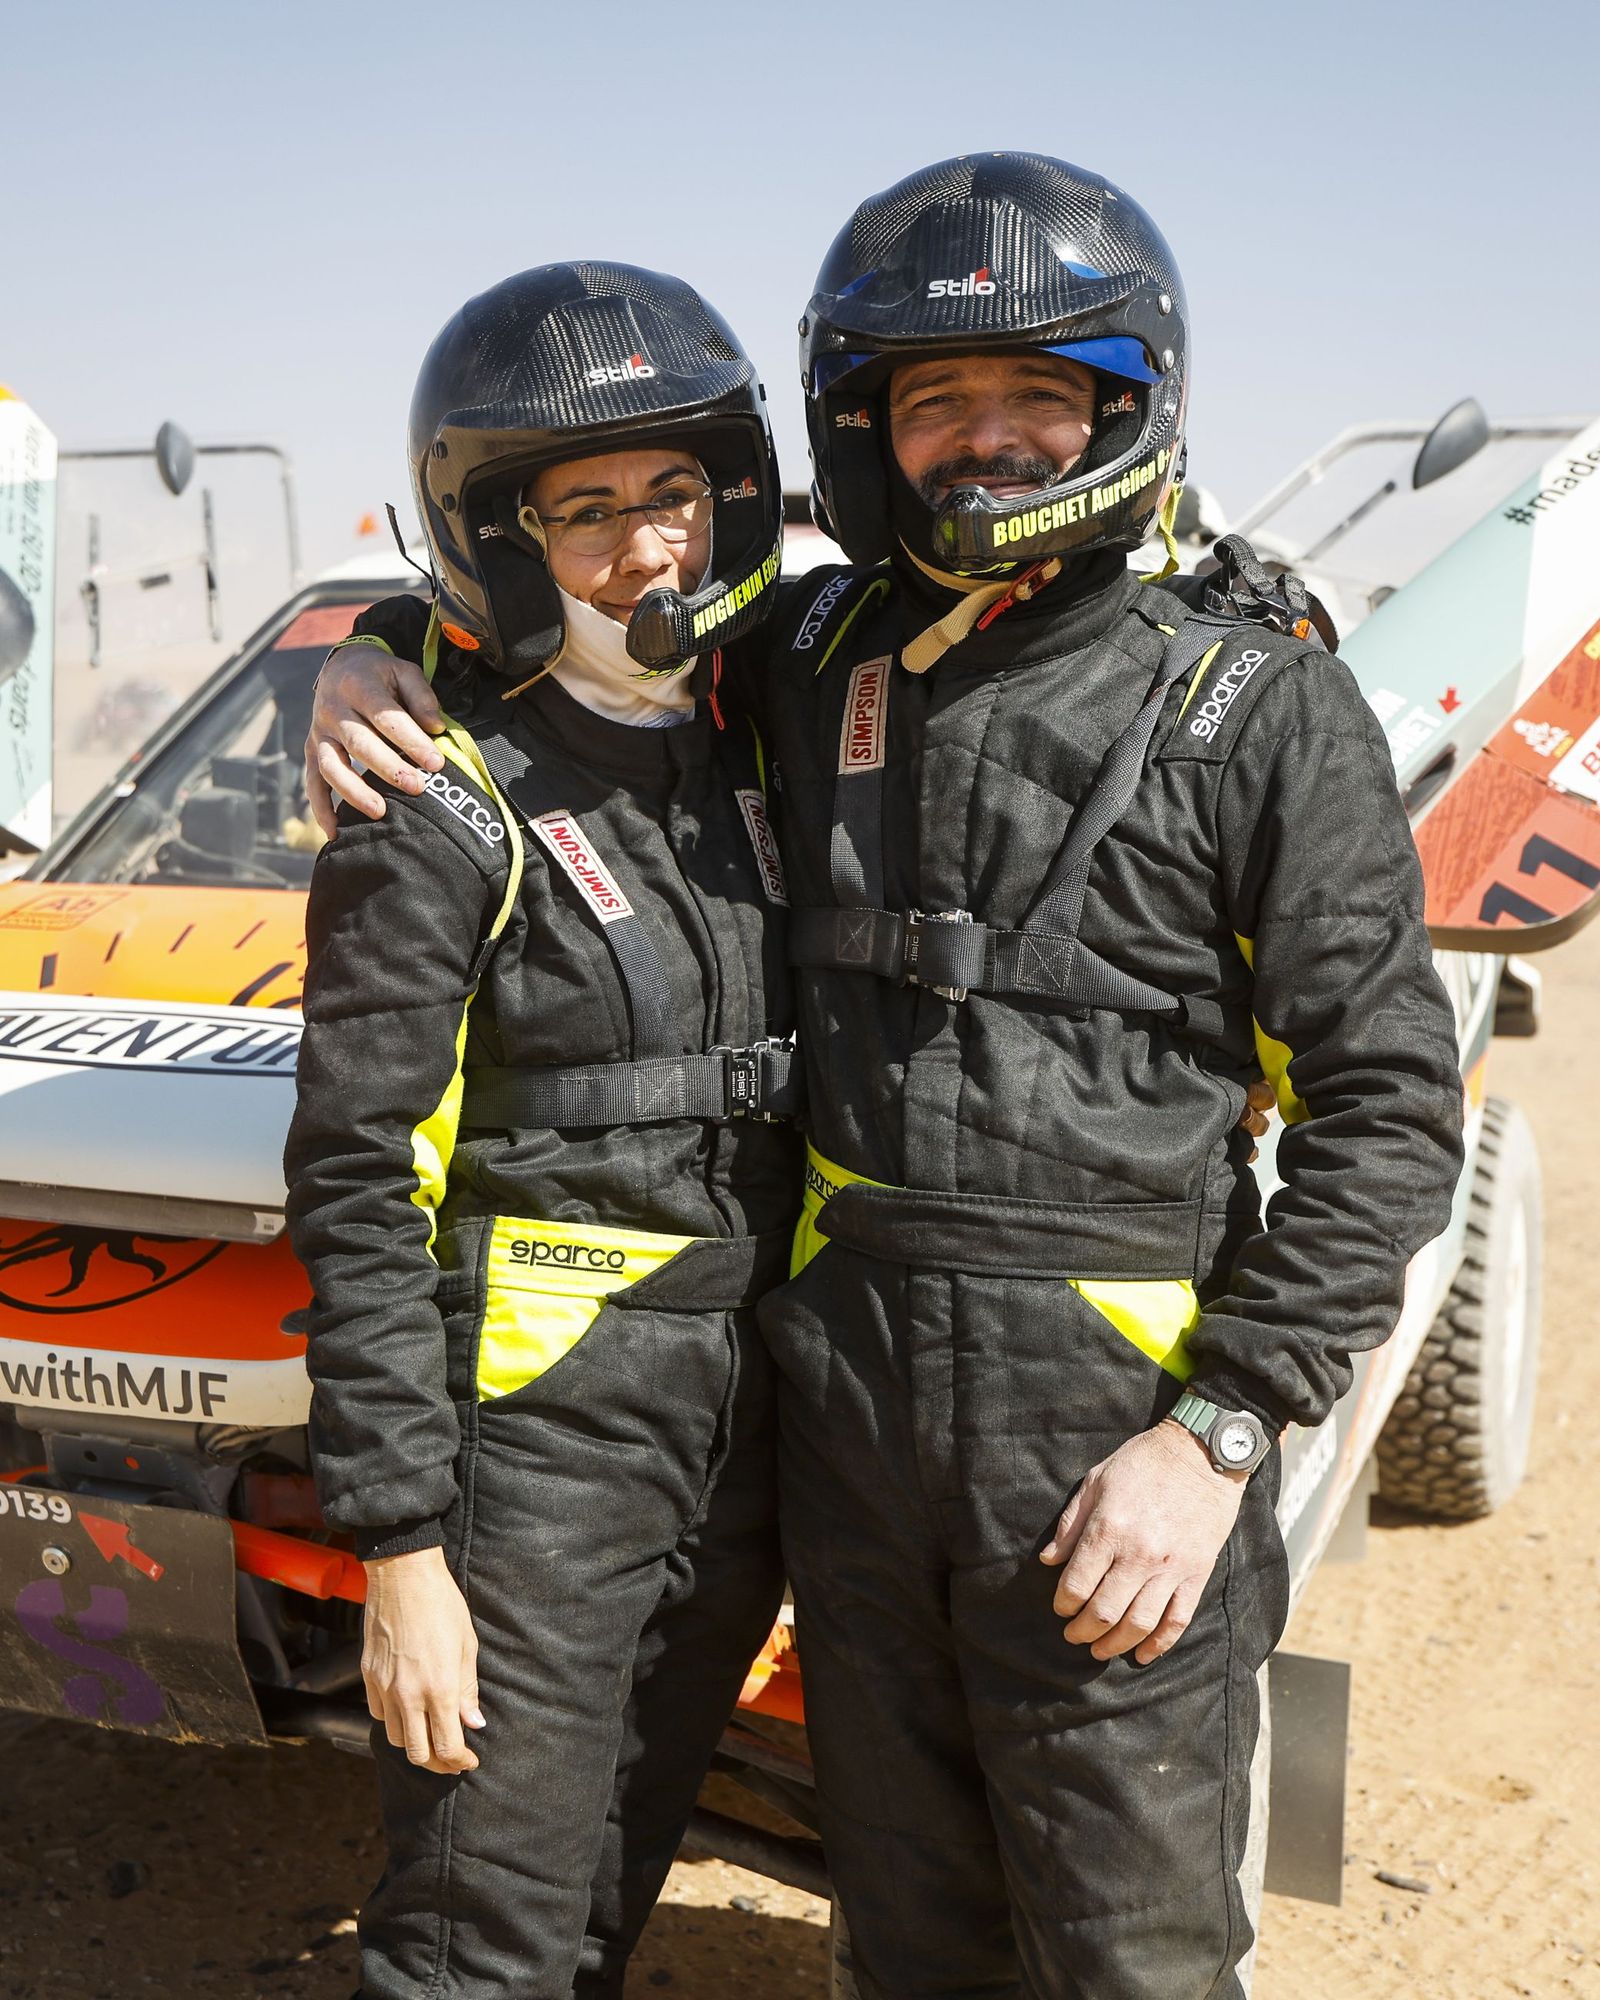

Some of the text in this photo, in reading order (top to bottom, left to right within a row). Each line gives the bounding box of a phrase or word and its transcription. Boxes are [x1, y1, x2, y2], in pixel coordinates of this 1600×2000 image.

[993, 492, 1088, 548] BOUCHET
[1091, 460, 1157, 514] Aurélien
[693, 568, 764, 639] HUGUENIN
[796, 576, 853, 650] sparco
[851, 671, 879, 760] SIMPSON
[1190, 649, 1263, 738] sparco
[421, 767, 505, 842] parco
[549, 825, 621, 910] SIMPSON
[750, 803, 784, 896] SIMPSON
[0, 1015, 299, 1067] VENTU
[510, 1239, 626, 1269] sparco
[0, 1352, 228, 1417] withMJF
